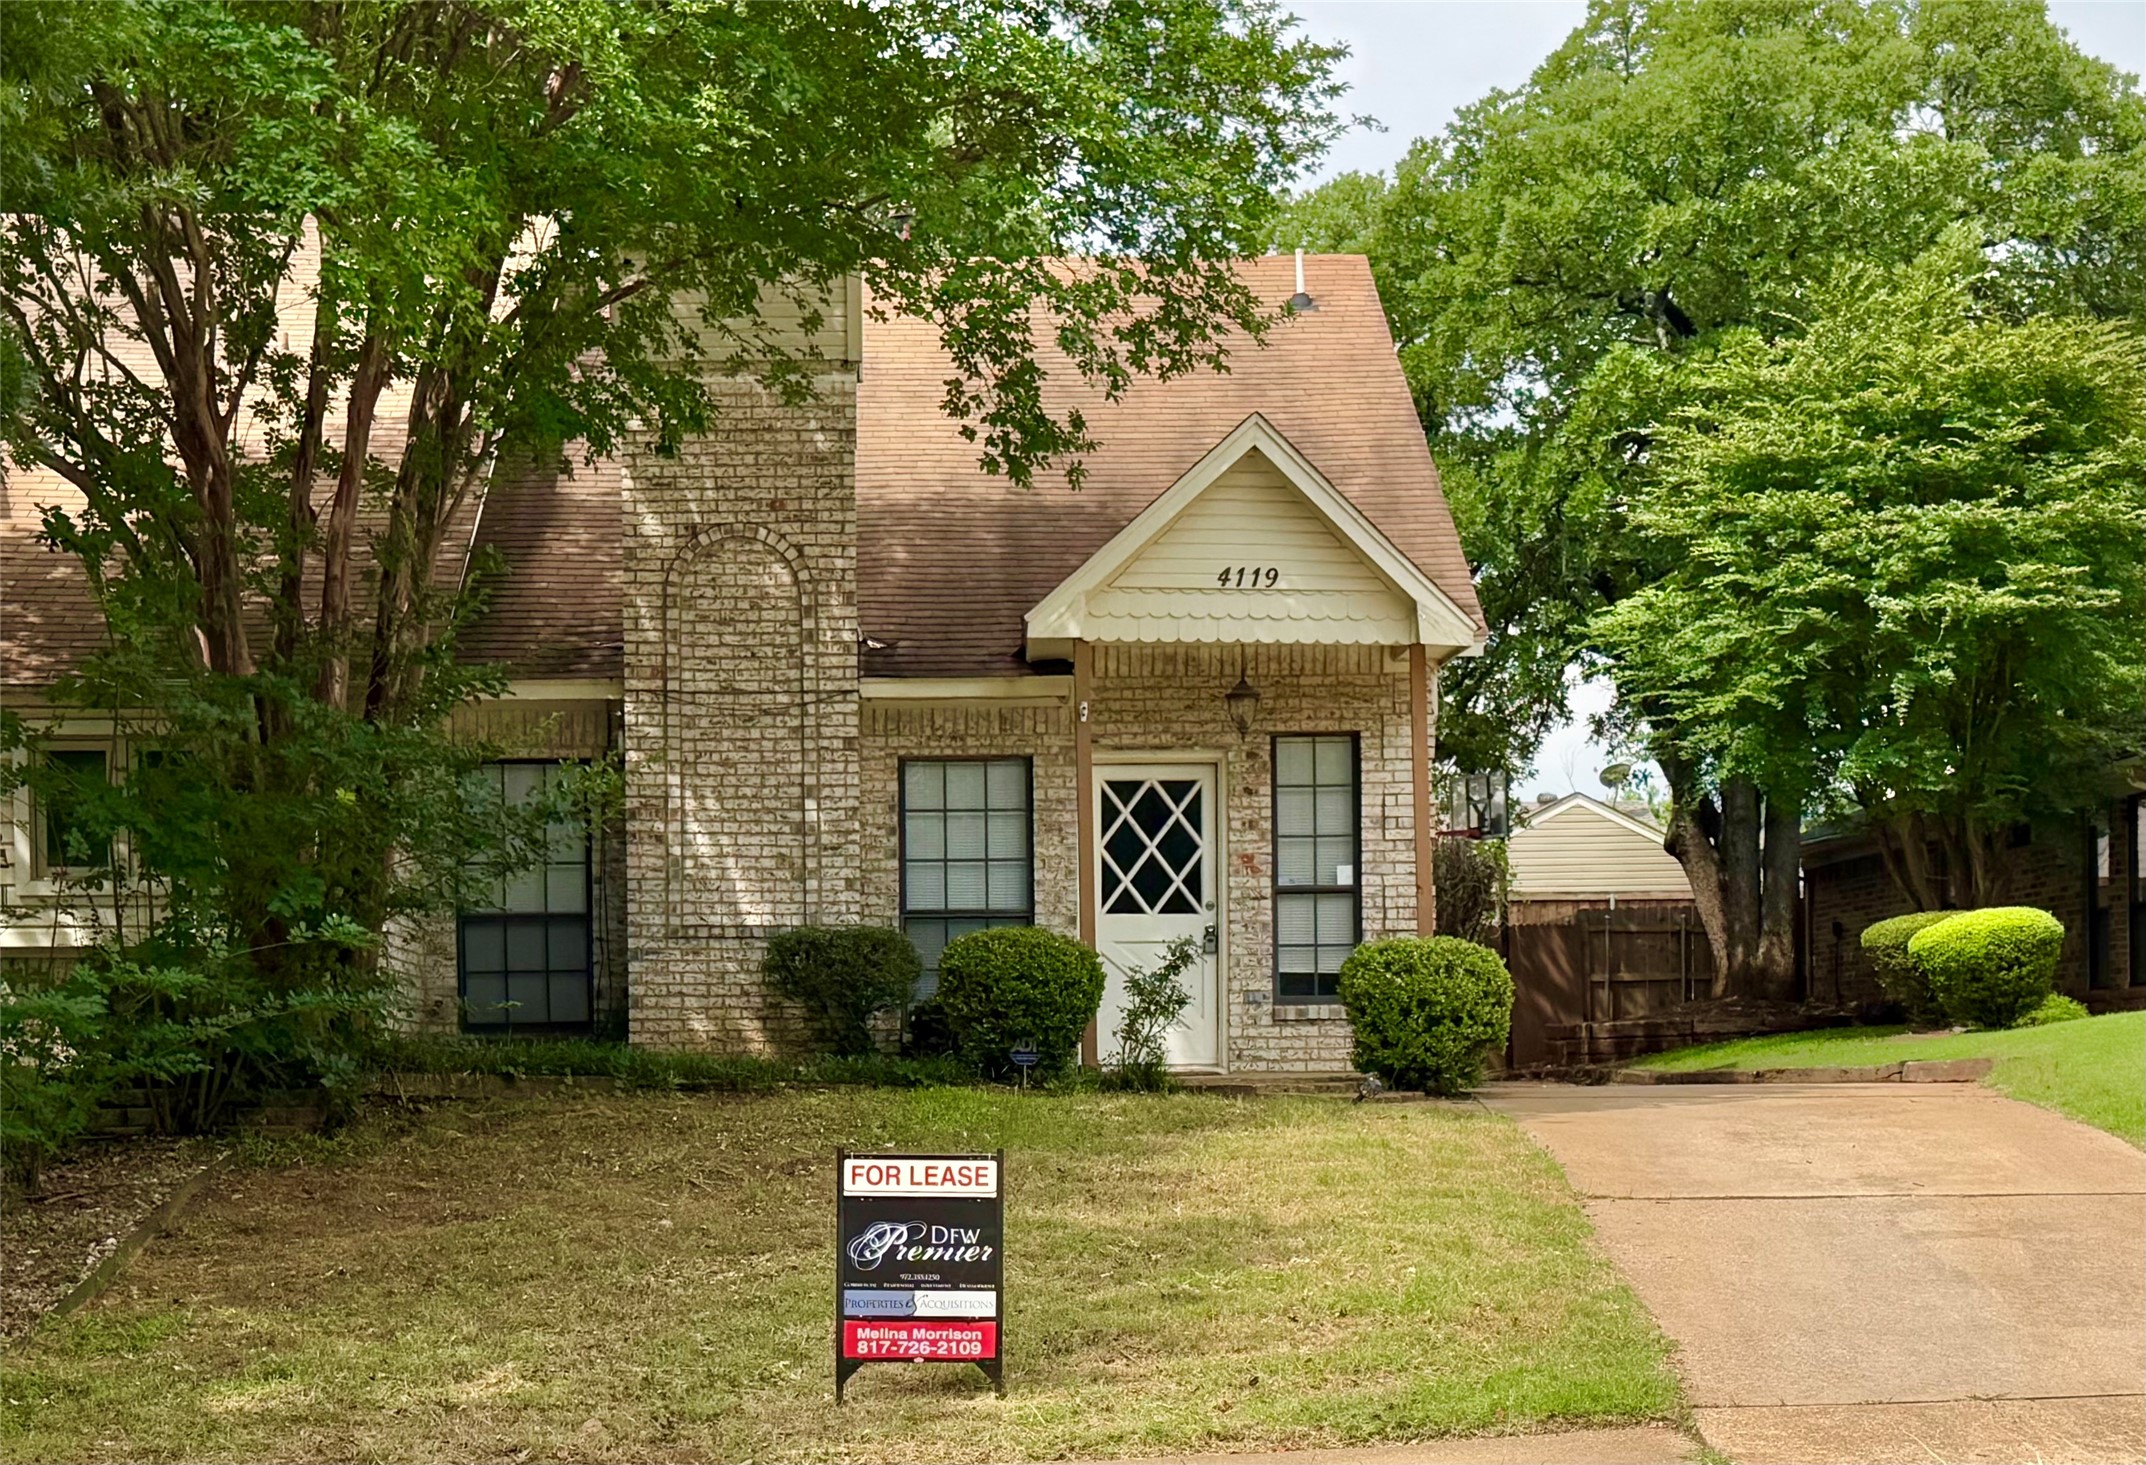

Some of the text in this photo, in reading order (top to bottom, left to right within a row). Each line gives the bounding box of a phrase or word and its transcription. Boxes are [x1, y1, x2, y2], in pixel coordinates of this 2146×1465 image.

[1217, 566, 1279, 588] 4119
[851, 1165, 989, 1187] FOR LEASE
[931, 1225, 981, 1245] DFW
[847, 1221, 993, 1271] Premier
[845, 1298, 904, 1309] PROPERTIES
[920, 1299, 994, 1310] ACQUISITIONS
[857, 1328, 982, 1340] Melina Morrison
[857, 1341, 982, 1355] 817-726-2109
